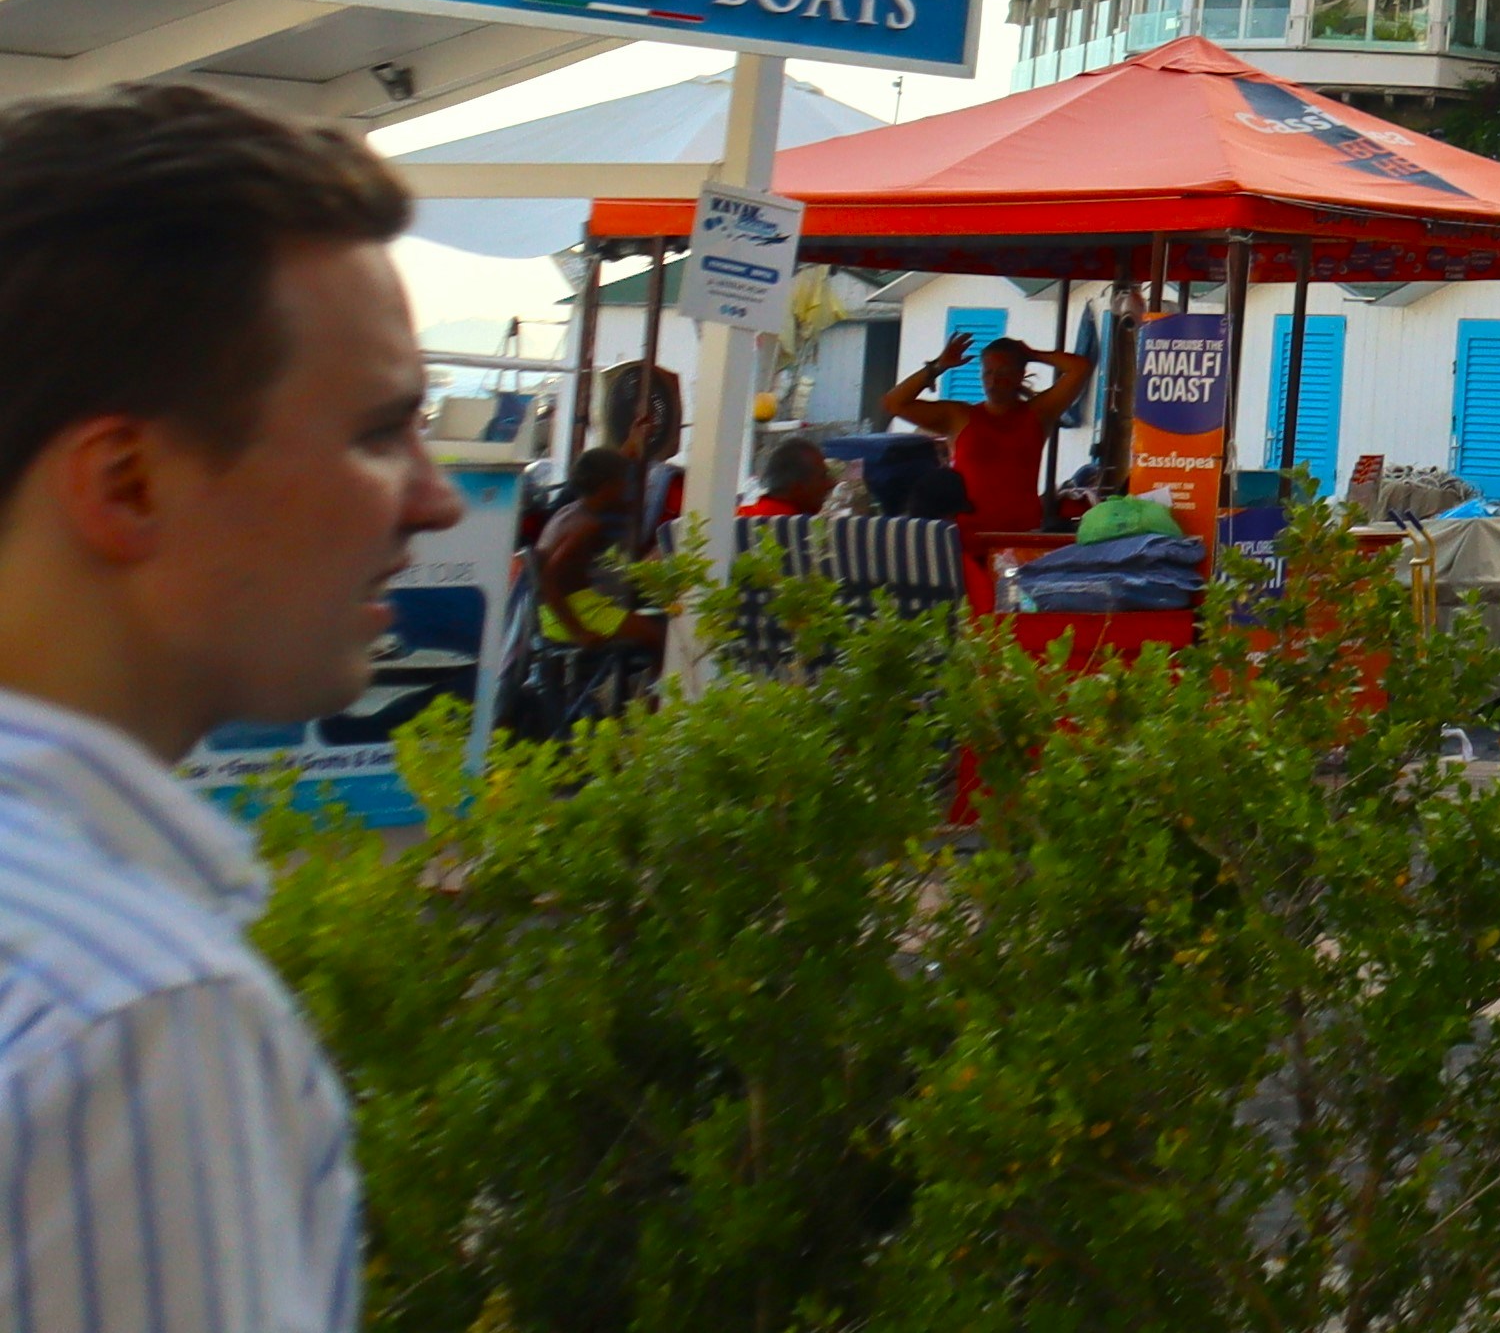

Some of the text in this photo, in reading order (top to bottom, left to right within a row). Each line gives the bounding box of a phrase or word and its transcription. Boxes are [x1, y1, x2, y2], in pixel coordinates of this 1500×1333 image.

[1145, 339, 1224, 351] SLOW CRUISE THE
[1143, 351, 1222, 377] AMALFI
[1147, 377, 1215, 403] COAST
[1137, 450, 1215, 472] Cassiopea
